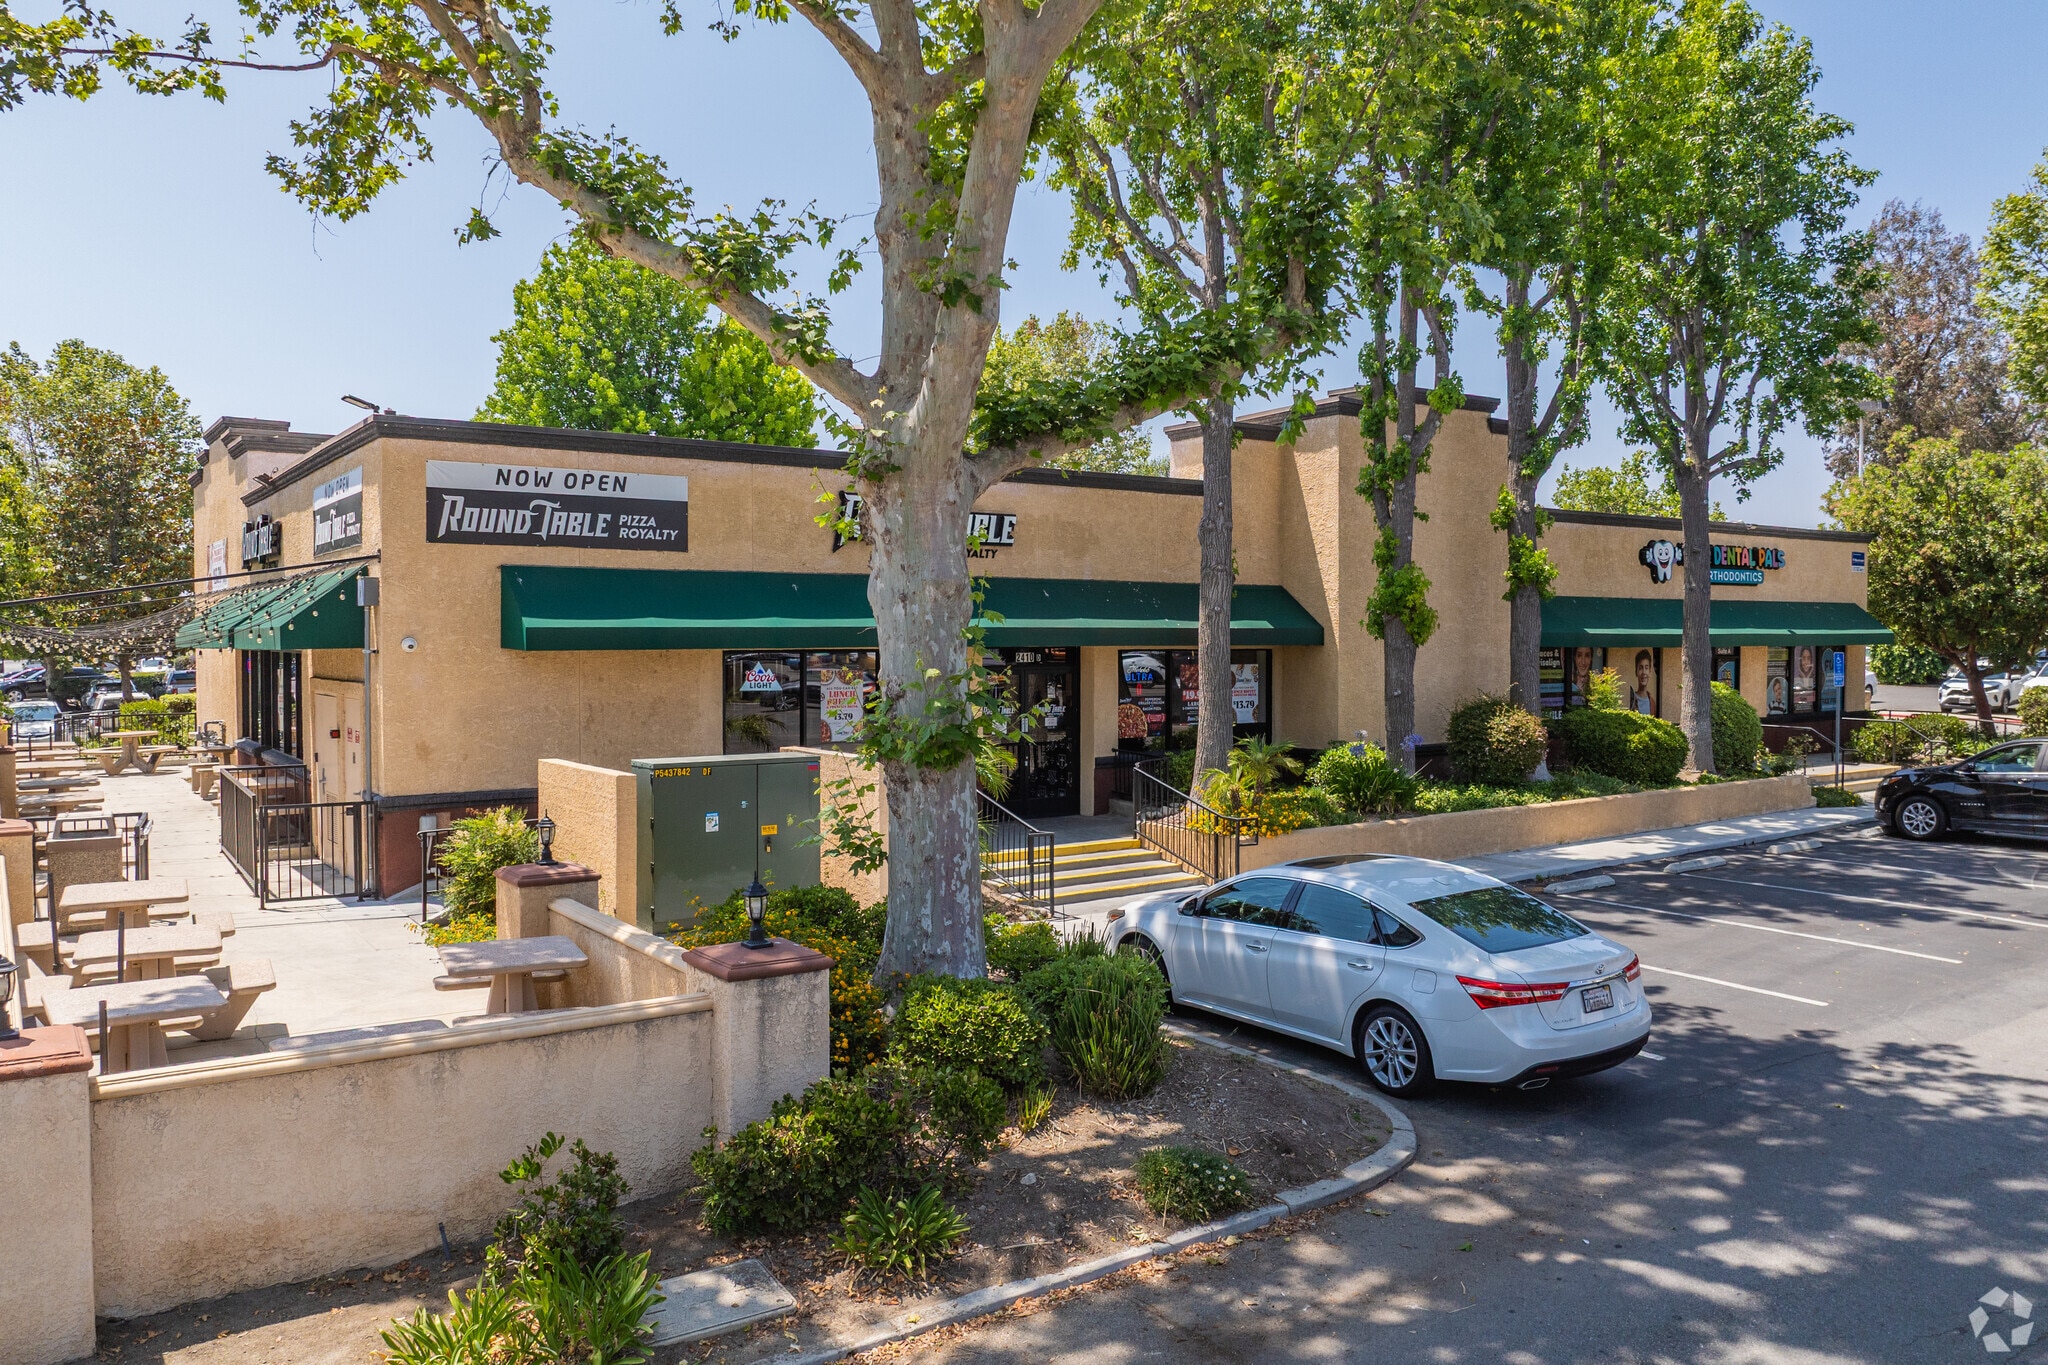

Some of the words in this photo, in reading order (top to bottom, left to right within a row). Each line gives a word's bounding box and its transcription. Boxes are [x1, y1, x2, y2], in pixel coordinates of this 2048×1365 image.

[335, 475, 349, 495] OPEN
[495, 468, 553, 489] NOW
[563, 472, 628, 493] OPEN
[437, 493, 532, 539] ROUND
[529, 499, 612, 541] TABLE
[618, 514, 657, 528] PIZZA
[618, 527, 679, 541] ROYALTY
[967, 513, 1017, 545] BLE
[966, 548, 998, 559] YALTY
[1713, 546, 1757, 567] DENTAL
[1758, 549, 1786, 568] PALS
[1709, 570, 1763, 582] RTHODONTICS
[1016, 653, 1034, 662] 2410
[745, 670, 776, 683] Coors
[1126, 672, 1153, 682] ULTRA
[829, 690, 856, 698] LUNCH
[1233, 700, 1255, 709] $13.79
[655, 767, 690, 778] P5437842
